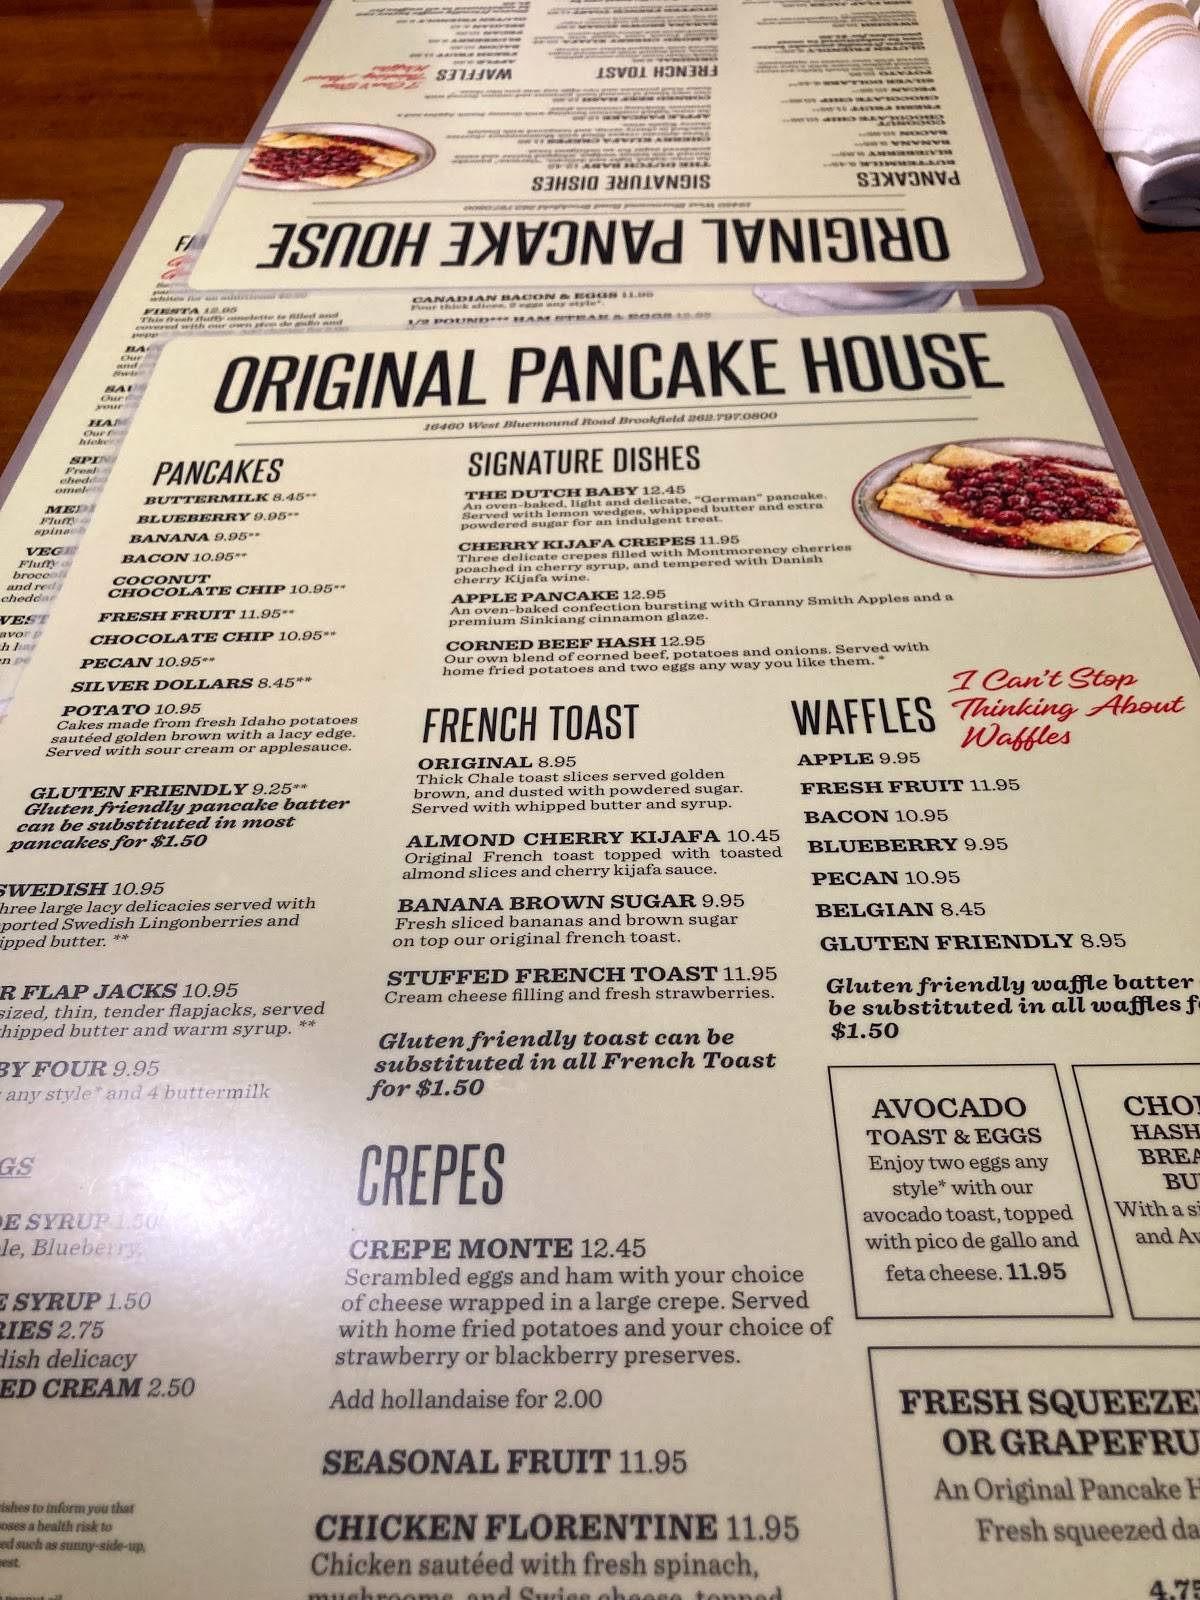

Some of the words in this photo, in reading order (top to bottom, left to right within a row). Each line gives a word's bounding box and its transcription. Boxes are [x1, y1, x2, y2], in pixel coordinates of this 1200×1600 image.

[436, 68, 512, 81] WAFFLES
[596, 66, 646, 78] TOAST
[654, 65, 718, 78] FRENCH
[532, 176, 598, 191] DISHES
[606, 174, 710, 190] SIGNATURE
[857, 170, 960, 187] PANCAKES
[256, 222, 431, 268] HOUSE
[440, 220, 683, 266] PANCAKE
[702, 217, 950, 264] ORIGINAL
[412, 295, 497, 303] CANADIAN
[214, 352, 486, 414] ORIGINAL
[508, 339, 786, 404] PANCAKE
[801, 333, 1004, 393] HOUSE
[424, 422, 464, 431] 16460
[503, 418, 579, 428] Bluemound
[581, 416, 616, 426] Road
[618, 415, 685, 424] Brookfield
[688, 412, 777, 422] 262.797.0800
[468, 448, 603, 476] SIGNATURE
[614, 445, 700, 472] DISHES
[152, 458, 284, 486] PANCAKES
[144, 493, 268, 505] BUTTERMILK
[463, 502, 482, 510] An
[486, 500, 567, 509] oven-baked,
[571, 499, 602, 508] light
[606, 498, 630, 506] and
[767, 492, 827, 502] pancake.
[465, 490, 506, 500] THE
[511, 488, 580, 499] DUTCH
[586, 487, 638, 497] BABY
[644, 486, 685, 495] 12.45
[136, 513, 250, 524] BLUEBERRY
[129, 533, 209, 543] BANANA
[458, 541, 539, 551] CHERRY
[542, 539, 615, 549] KIJAFA
[619, 536, 695, 548] CREPES
[700, 536, 739, 544] 11.95
[121, 553, 190, 564] BACON
[113, 574, 211, 586] COCONUT
[454, 576, 500, 585] cherry
[505, 574, 548, 584] Kijafa
[552, 574, 589, 582] wine.
[108, 586, 232, 598] CHOCOLATE
[236, 585, 286, 595] CHIP
[451, 593, 517, 604] APPLE
[521, 590, 618, 602] PANCAKE
[624, 590, 666, 599] 12.95
[98, 611, 168, 622] FRESH
[171, 610, 235, 620] FRUIT
[446, 640, 533, 651] CORNED
[538, 638, 592, 649] BEEF
[597, 637, 656, 648] HASH
[661, 636, 705, 646] 12.95
[80, 657, 153, 669] PECAN
[71, 680, 149, 692] SILVER
[153, 678, 253, 690] DOLLARS
[948, 669, 979, 692] I
[1068, 667, 1138, 690] Stop
[61, 704, 150, 716] POTATO
[155, 704, 200, 714] 10.95
[791, 697, 936, 735] WAFFLES
[951, 697, 1078, 722] Thinking
[1085, 694, 1186, 717] About
[423, 706, 537, 743] FRENCH
[550, 704, 639, 740] TOAST
[960, 723, 1071, 751] Waffles
[418, 757, 532, 770] ORIGINAL
[538, 756, 576, 768] 8.95
[797, 753, 874, 766] APPLE
[880, 752, 920, 764] 9.95
[30, 786, 126, 799] GLUTEN
[128, 784, 249, 797] FRIENDLY
[800, 781, 884, 794] FRESH
[888, 780, 964, 792] FRUIT
[970, 779, 1020, 791] 11.95
[406, 834, 515, 848] ALMOND
[524, 832, 624, 846] CHERRY
[630, 830, 720, 844] KIJAFA
[728, 830, 780, 842] 10.45
[112, 882, 165, 895] 10.95
[815, 903, 933, 918] BELGIAN
[941, 902, 985, 916] 8.45
[22, 985, 89, 1000] FLAP
[93, 983, 178, 999] JACKS
[183, 983, 239, 998] 10.95
[831, 1022, 899, 1040] $1.50
[33, 1061, 107, 1078] FOUR
[113, 1060, 160, 1077] 9.95
[872, 1097, 1026, 1118] AVOCADO
[866, 1129, 947, 1145] TOAST
[954, 1130, 970, 1144] &
[974, 1128, 1042, 1144] EGGS
[358, 1143, 504, 1206] CREPES
[350, 1239, 451, 1260] CREPE
[458, 1238, 572, 1259] MONTE
[581, 1238, 646, 1258] 12.45
[886, 1264, 925, 1281] feta
[930, 1264, 1002, 1281] cheese.
[1006, 1262, 1066, 1280] 11.95
[13, 1292, 102, 1312] SYRUP
[107, 1292, 151, 1310] 1.50
[57, 1320, 104, 1339] 2.75
[42, 1377, 143, 1398] CREAM
[147, 1377, 195, 1398] 2.50
[899, 1389, 1022, 1415] FRESH
[1028, 1389, 1200, 1419] SQUEEZE
[322, 1449, 499, 1475] SEASONAL
[506, 1449, 611, 1474] FRUIT
[620, 1449, 686, 1474] 11.95
[934, 1478, 970, 1501] An
[974, 1477, 1076, 1506] Original
[1078, 1477, 1182, 1501] Pancake
[315, 1514, 478, 1542] CHICKEN
[485, 1514, 718, 1542] FLORENTINE
[728, 1515, 799, 1541] 11.95
[976, 1517, 1049, 1542] Fresh
[1054, 1516, 1168, 1546] squeezed
